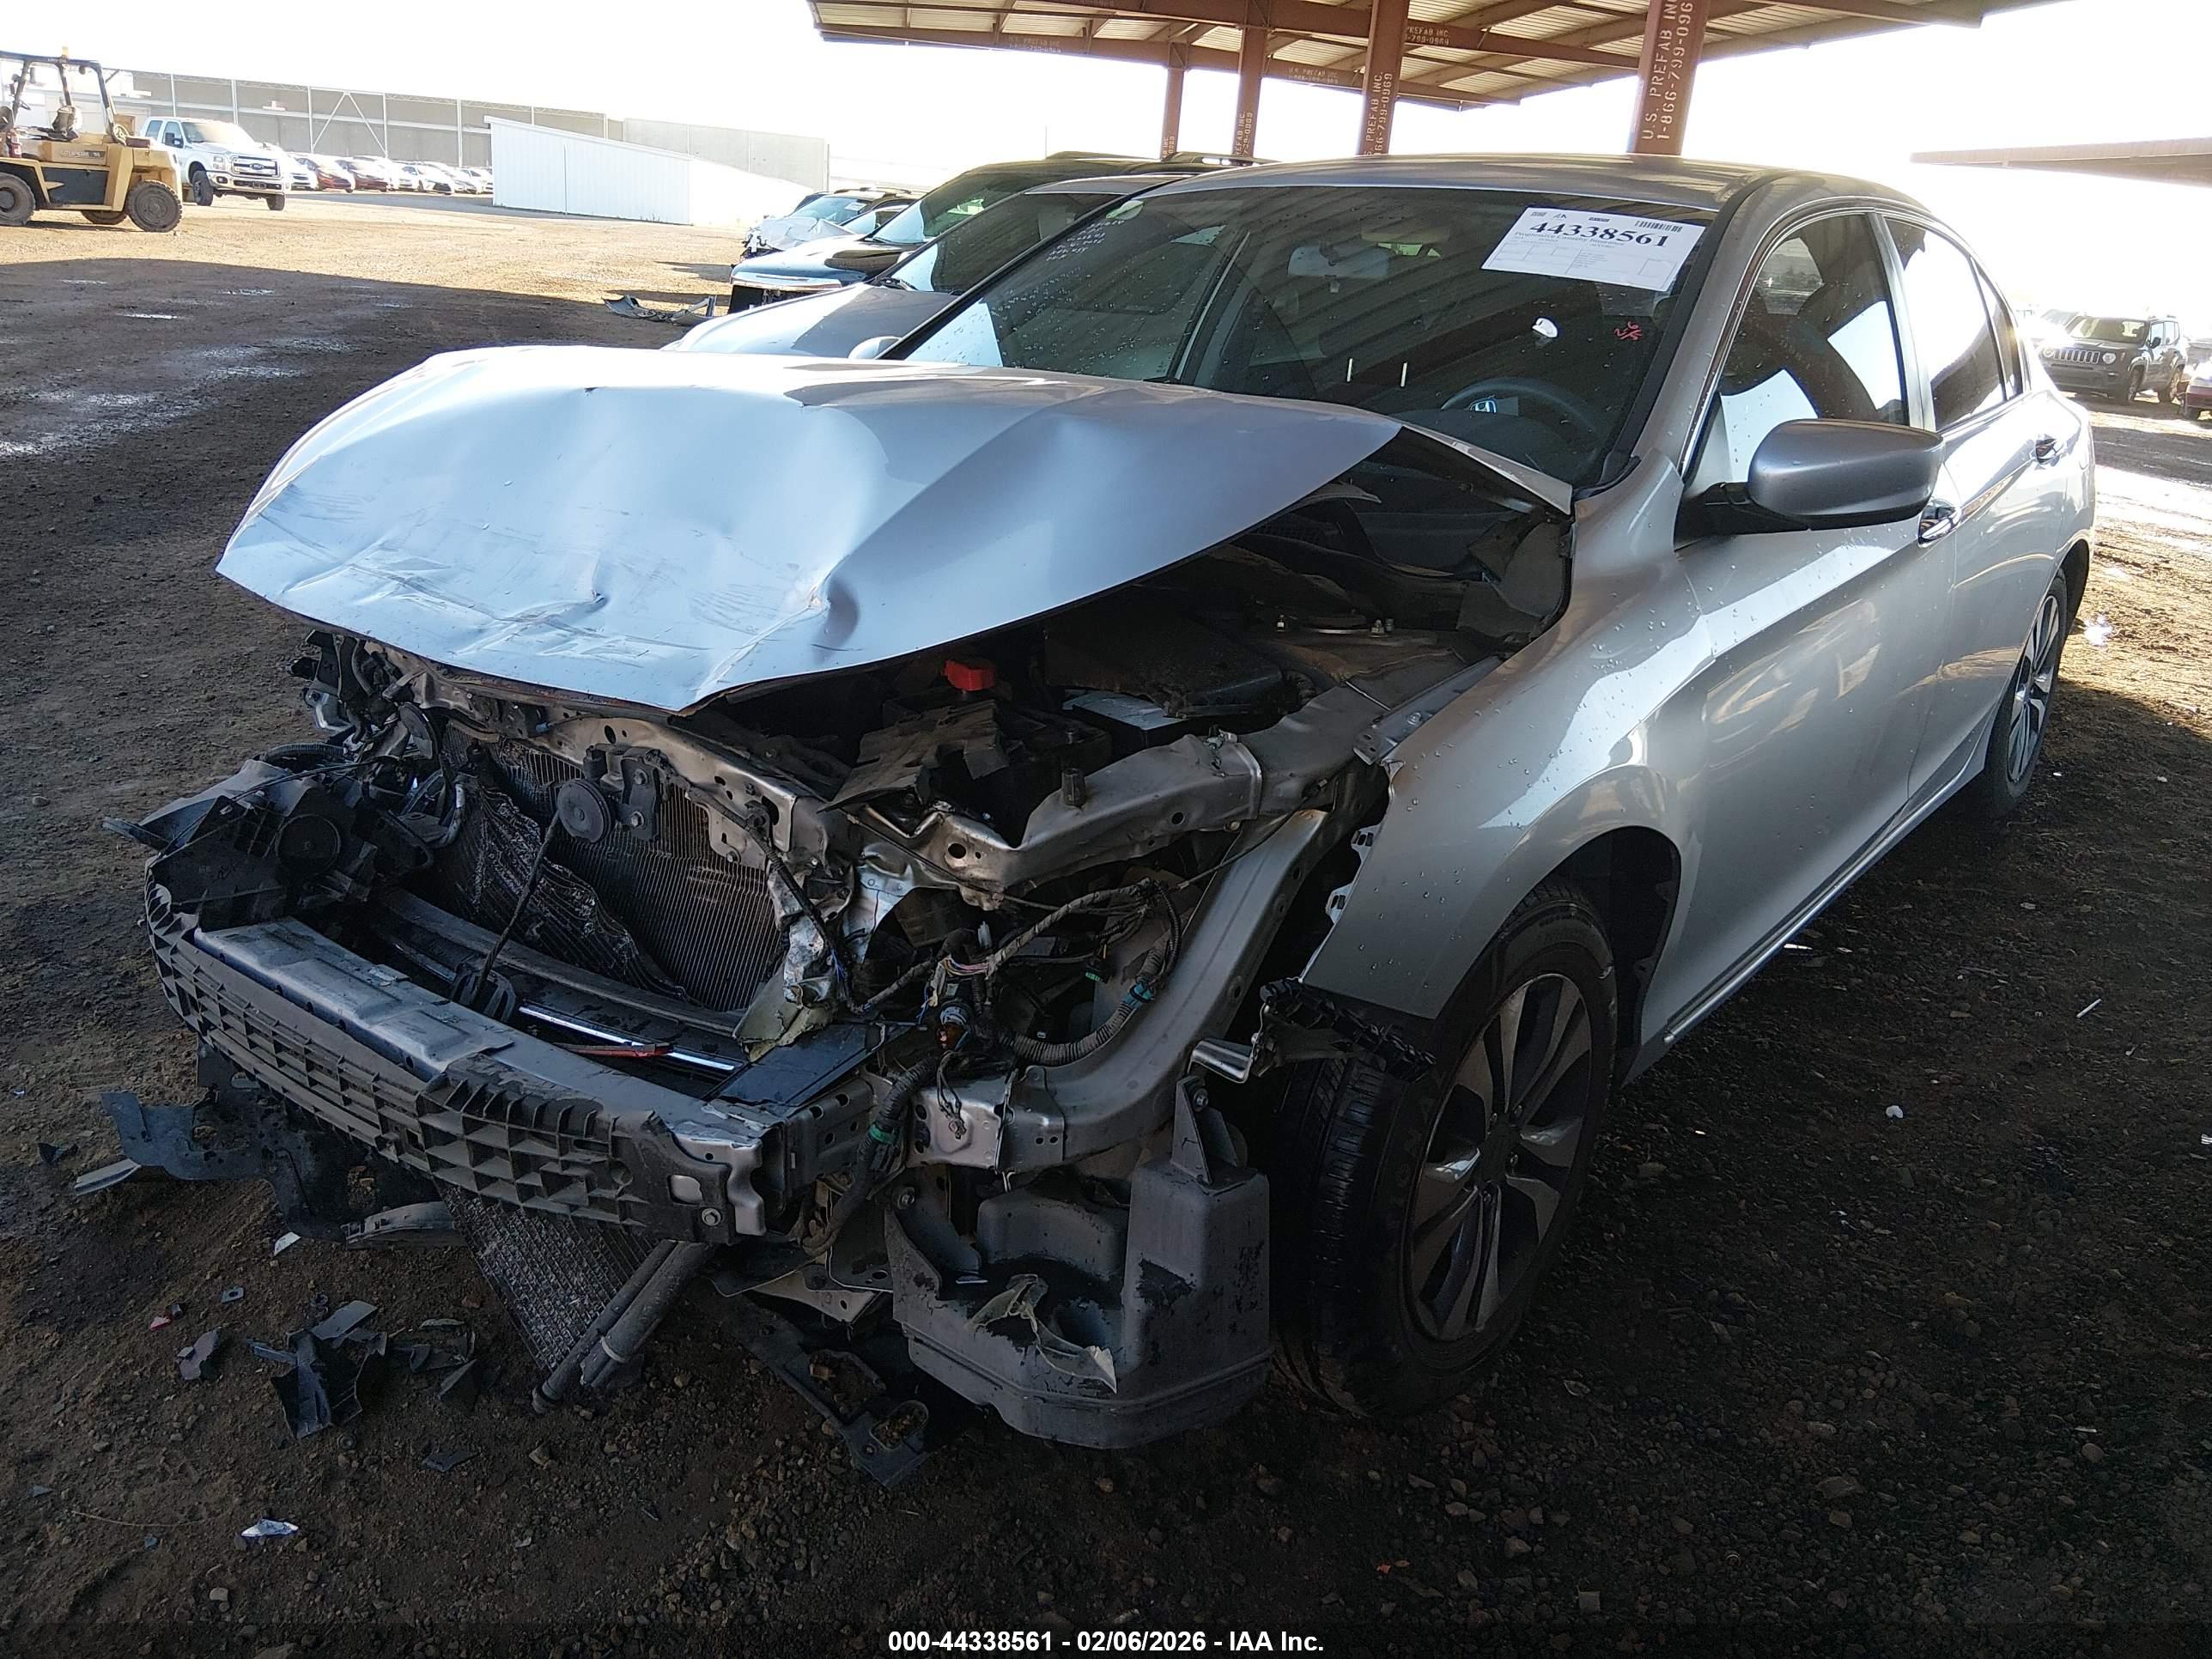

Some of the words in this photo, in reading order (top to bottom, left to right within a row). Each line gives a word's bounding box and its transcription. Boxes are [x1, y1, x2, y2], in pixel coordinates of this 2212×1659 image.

[1649, 29, 1673, 97] PREFAB
[1365, 99, 1380, 142] PREFAB
[1373, 71, 1383, 93] INC.
[1374, 72, 1393, 155] 66-799-0969
[1641, 107, 1659, 140] U.S.
[1529, 222, 1669, 247] 44338561
